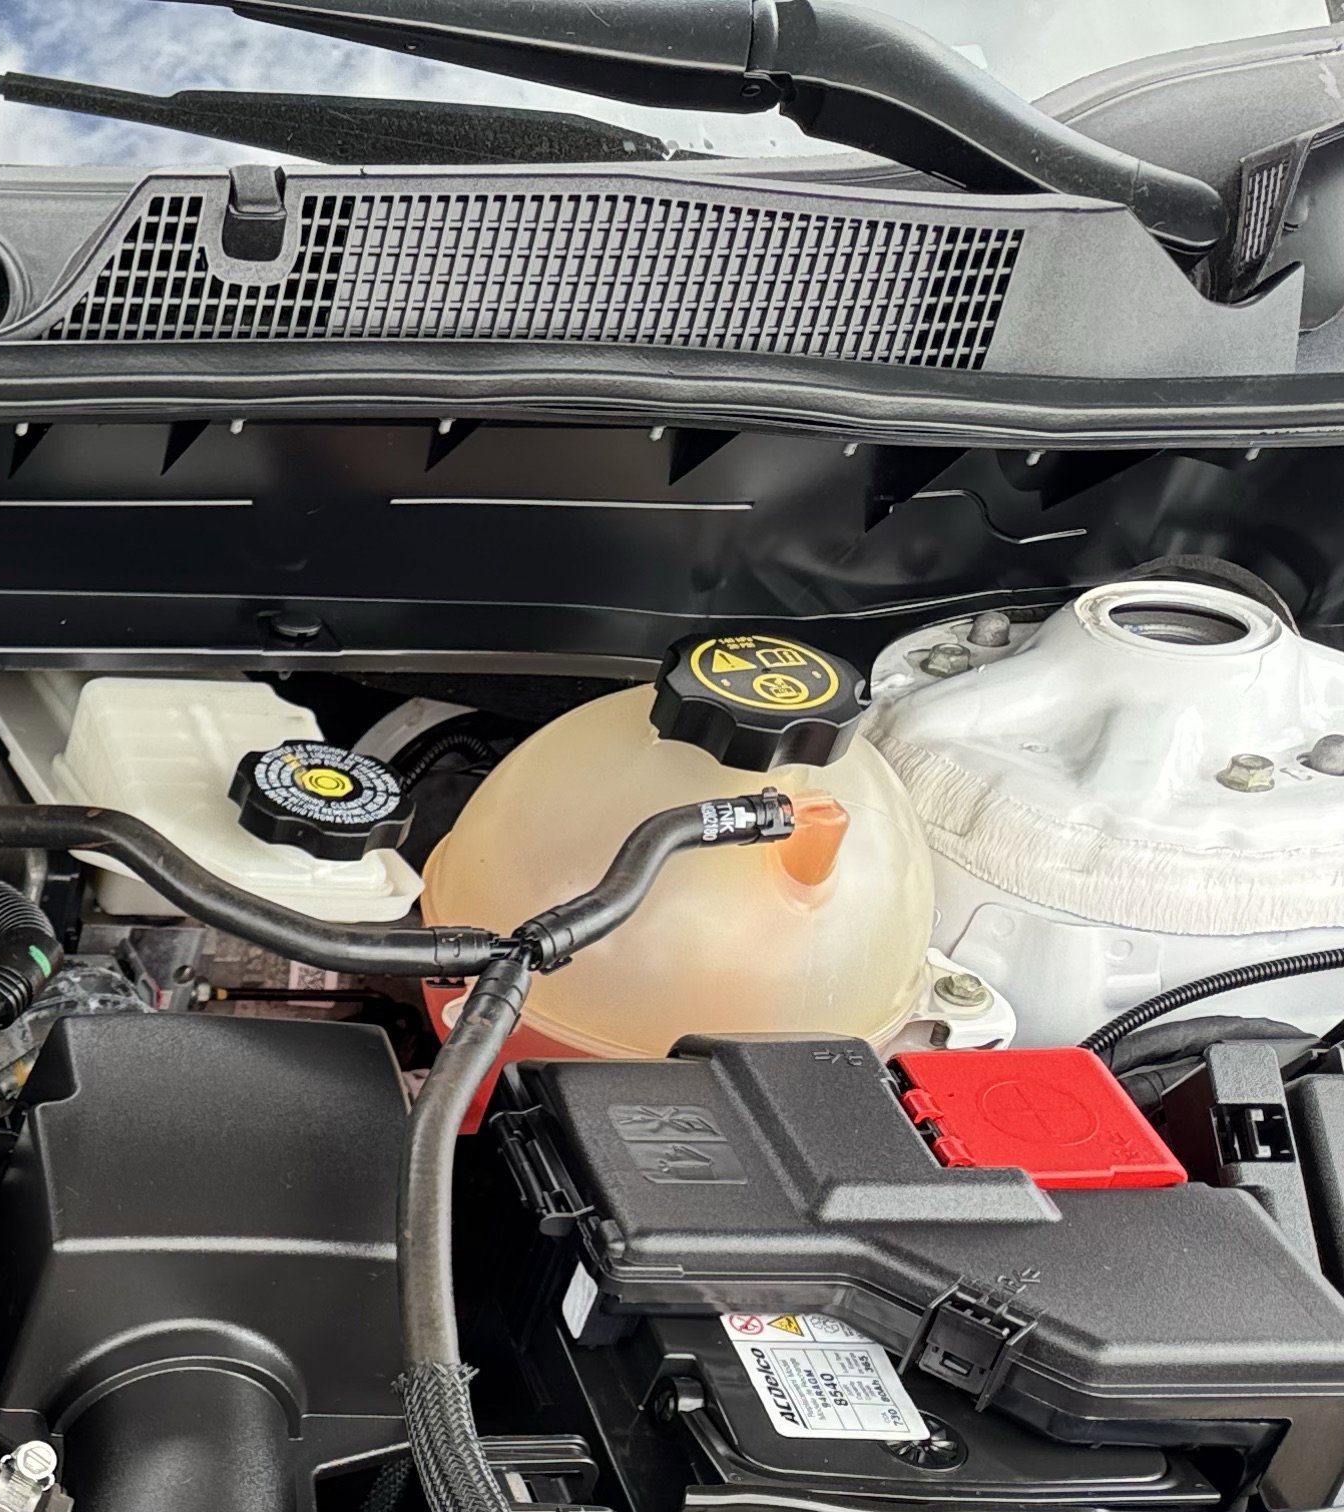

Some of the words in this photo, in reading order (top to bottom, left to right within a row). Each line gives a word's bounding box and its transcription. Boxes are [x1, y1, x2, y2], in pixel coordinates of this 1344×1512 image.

[716, 802, 734, 833] TNK
[857, 1355, 874, 1372] 365
[747, 1348, 800, 1425] ACDelco
[818, 1373, 849, 1406] 8540
[886, 1408, 904, 1425] 730
